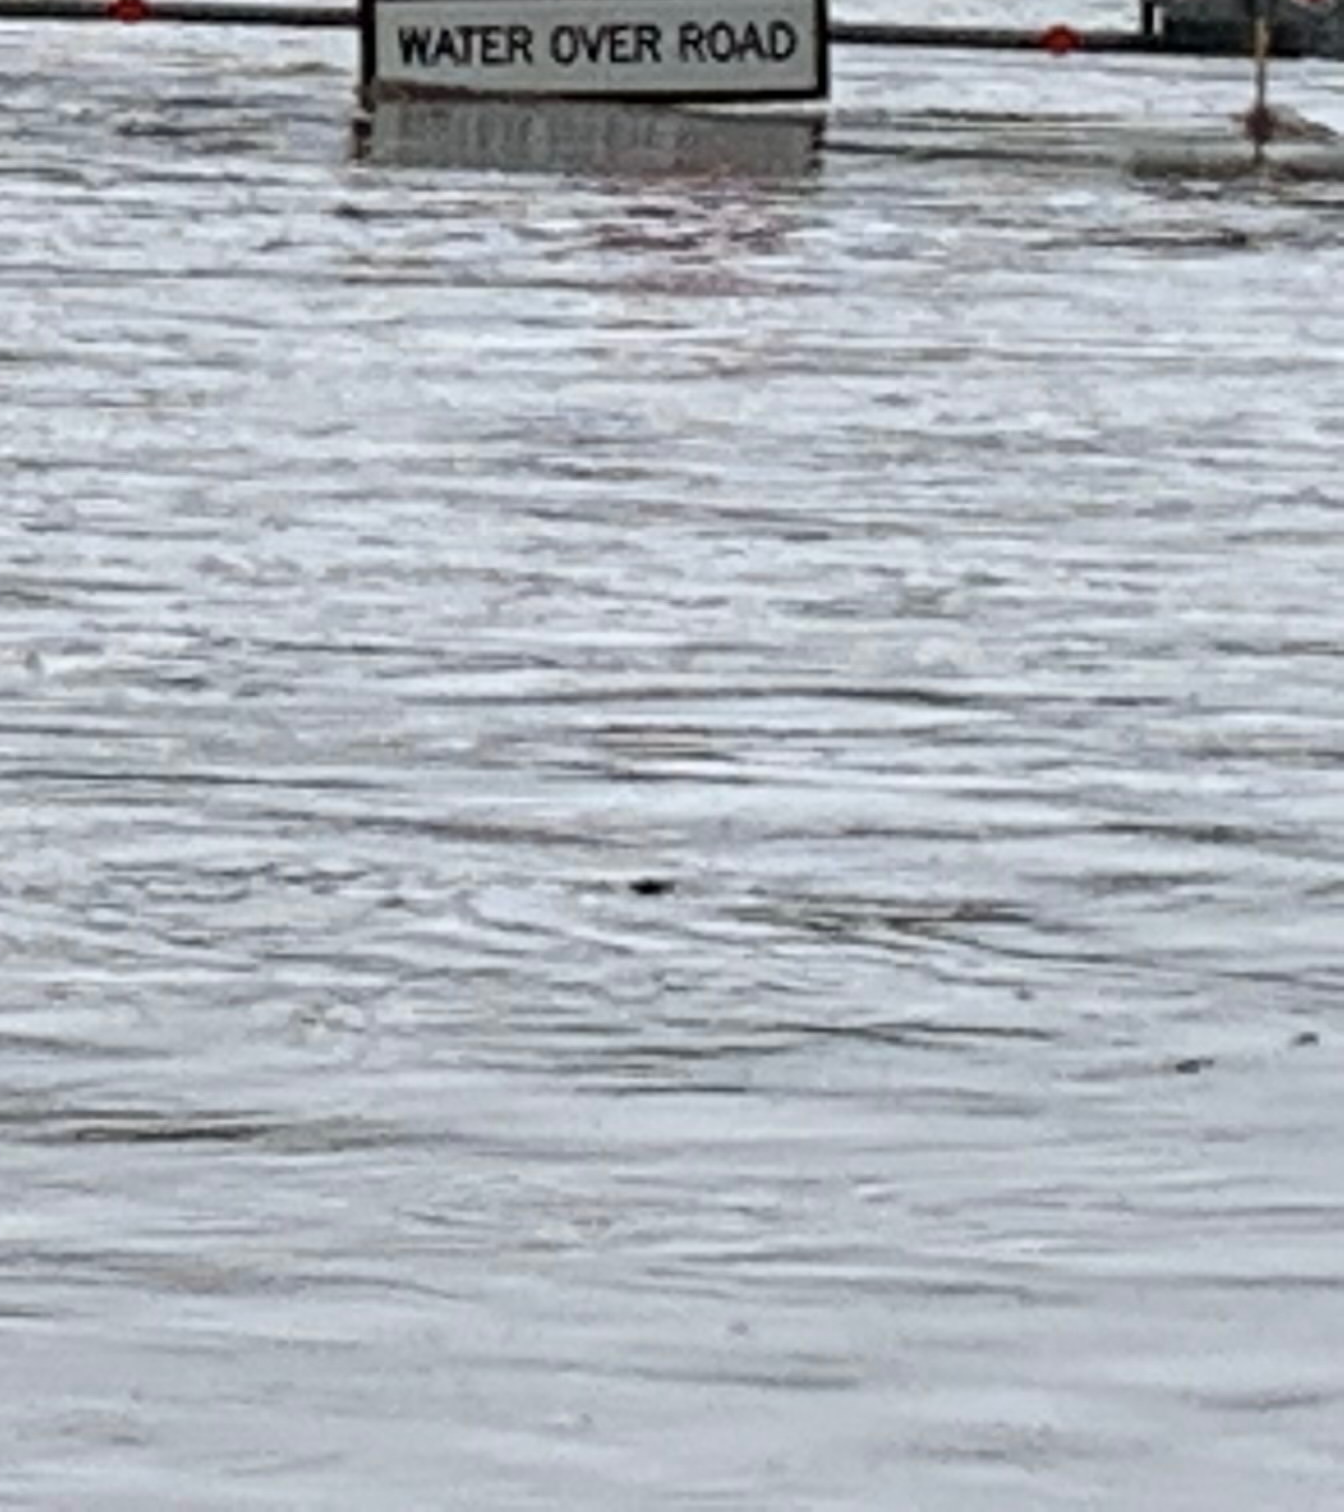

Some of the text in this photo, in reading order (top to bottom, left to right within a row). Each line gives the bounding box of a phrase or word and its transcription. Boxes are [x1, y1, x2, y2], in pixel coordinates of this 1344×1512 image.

[397, 20, 797, 67] WATER OVER ROAD
